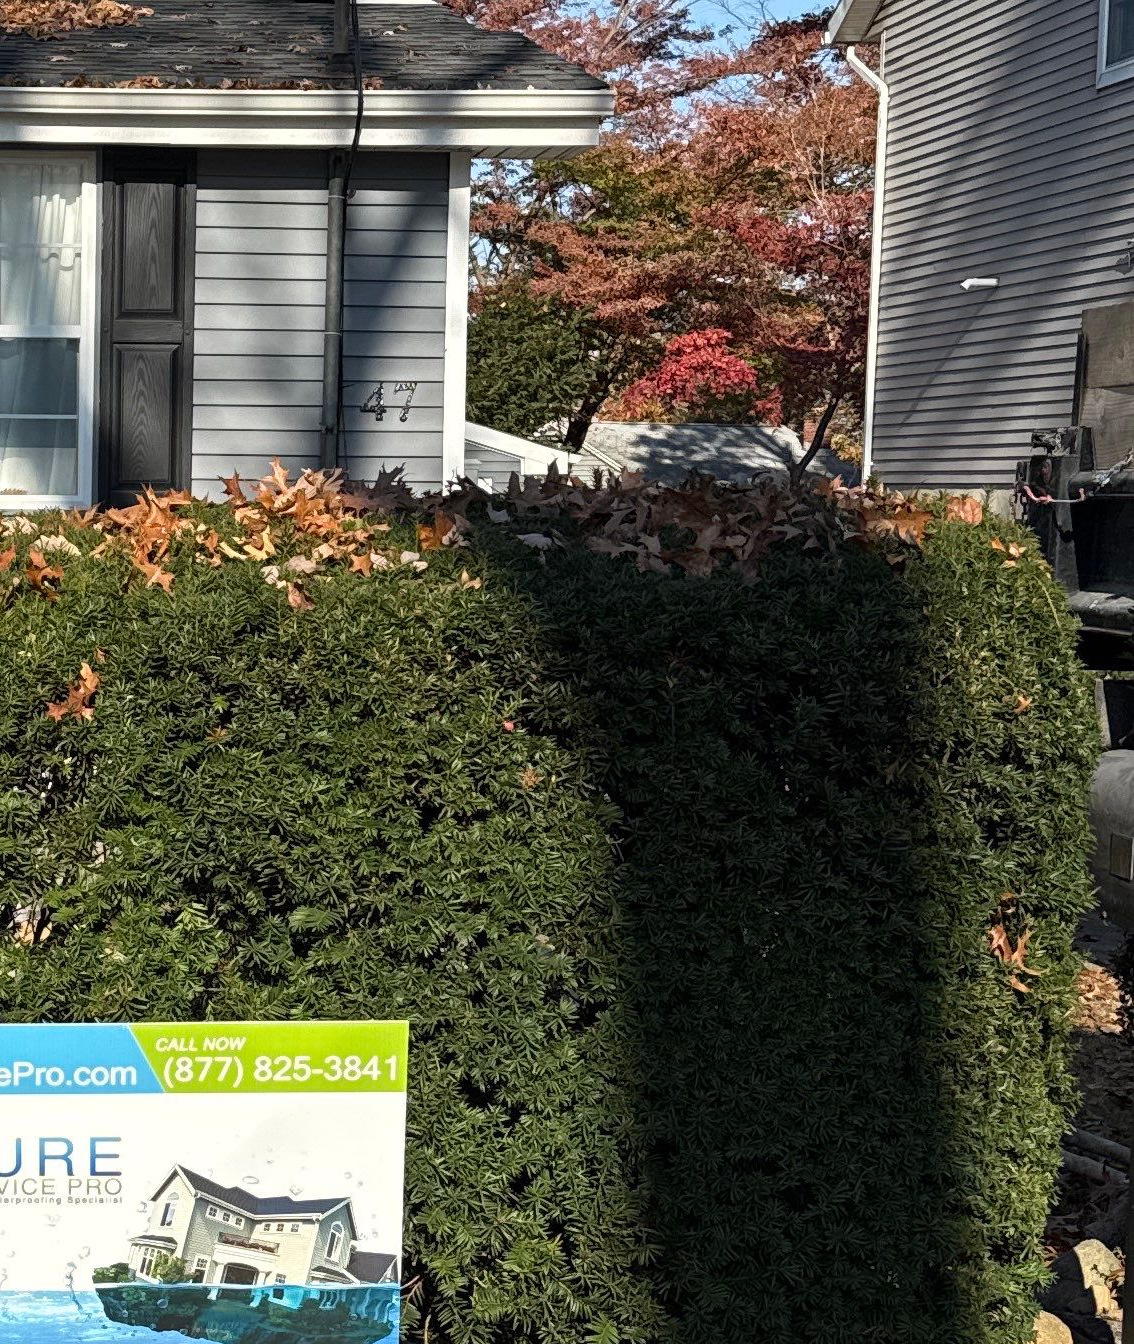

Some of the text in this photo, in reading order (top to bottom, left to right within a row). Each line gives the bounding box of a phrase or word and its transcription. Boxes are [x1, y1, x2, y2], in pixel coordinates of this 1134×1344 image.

[360, 382, 417, 422] 47
[155, 1036, 246, 1052] CALL NOW
[163, 1055, 398, 1088] (877) 825-3841
[68, 1178, 123, 1196] PRO
[67, 1195, 123, 1205] Specialist
